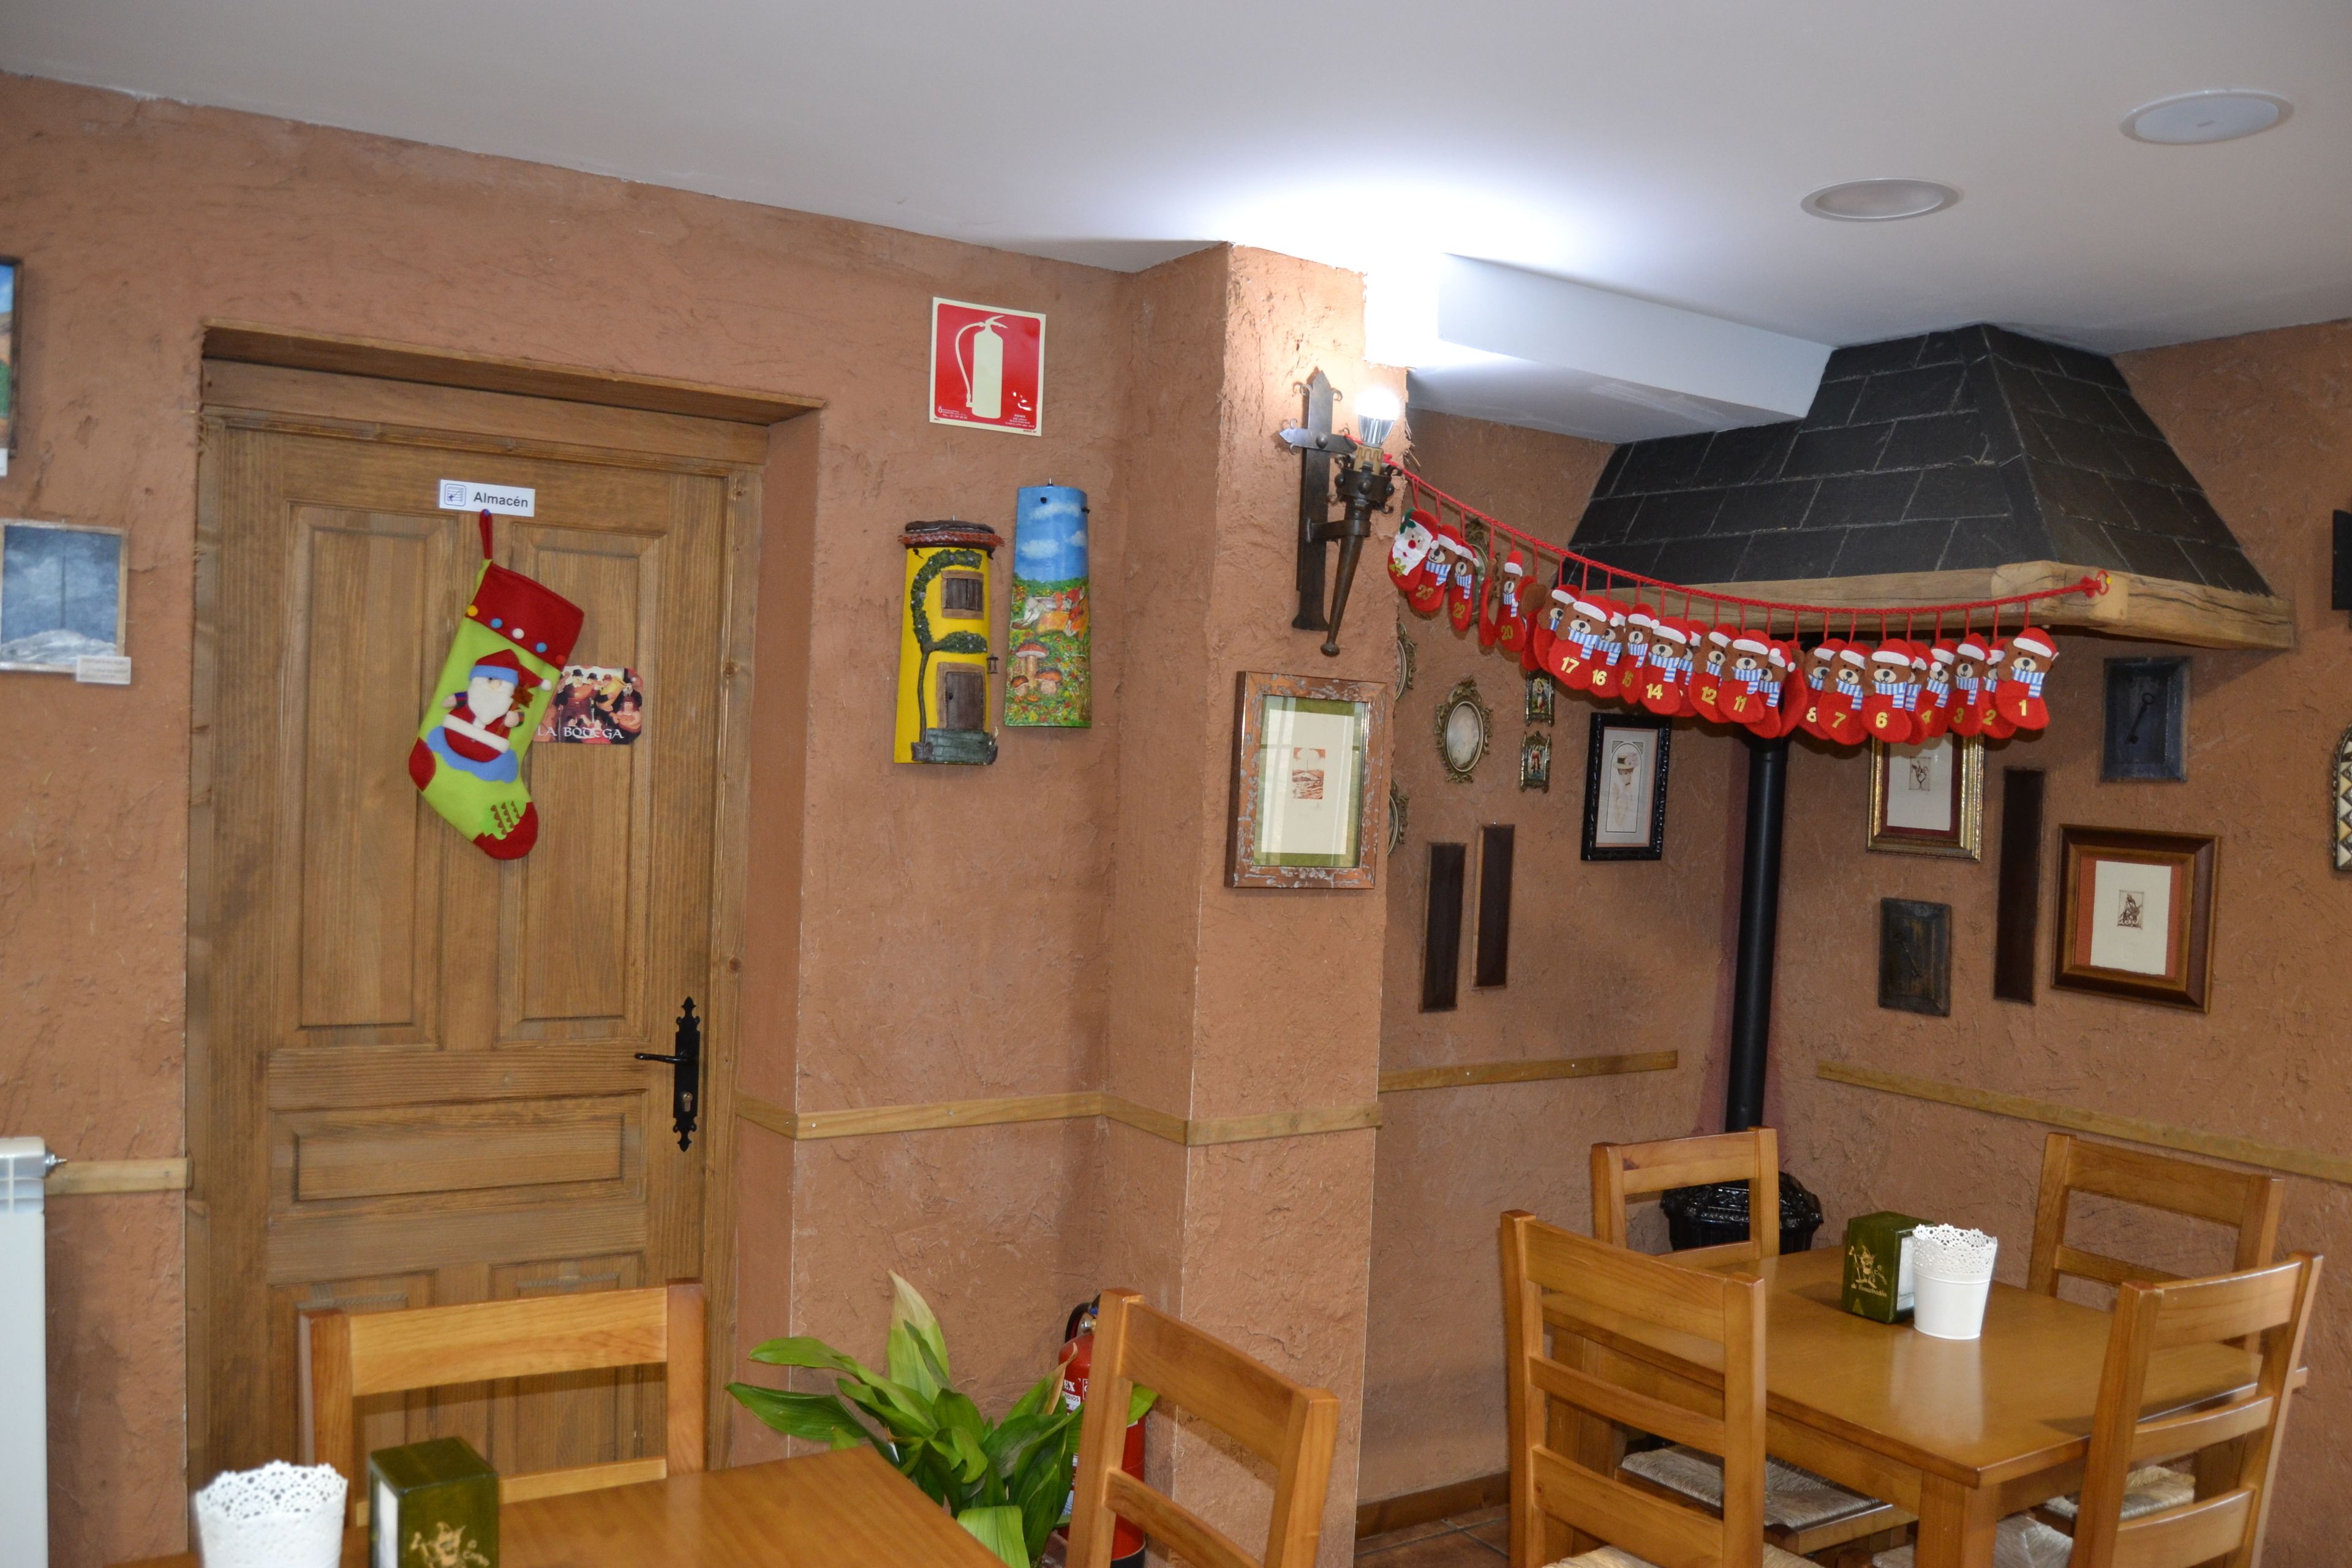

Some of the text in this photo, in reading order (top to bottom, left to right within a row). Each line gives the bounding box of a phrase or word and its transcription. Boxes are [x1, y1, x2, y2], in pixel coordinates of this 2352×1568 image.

[473, 492, 528, 508] Almacén
[1389, 557, 1407, 578] 24
[1415, 584, 1434, 601] 23
[1452, 601, 1466, 619] 22
[1501, 625, 1513, 641] 20
[1561, 656, 1580, 674] 17
[1592, 669, 1608, 687] 16
[1646, 683, 1664, 700] 14
[1701, 686, 1717, 706] 12
[1733, 695, 1747, 712] 11
[2019, 699, 2027, 716] 1
[1806, 707, 1817, 723] 8
[1832, 711, 1847, 728] 7
[1875, 711, 1889, 729] 6
[1921, 710, 1932, 725] 4
[1954, 707, 1964, 724] 3
[1983, 709, 1997, 726] 2
[538, 725, 624, 740] LA BODEGA
